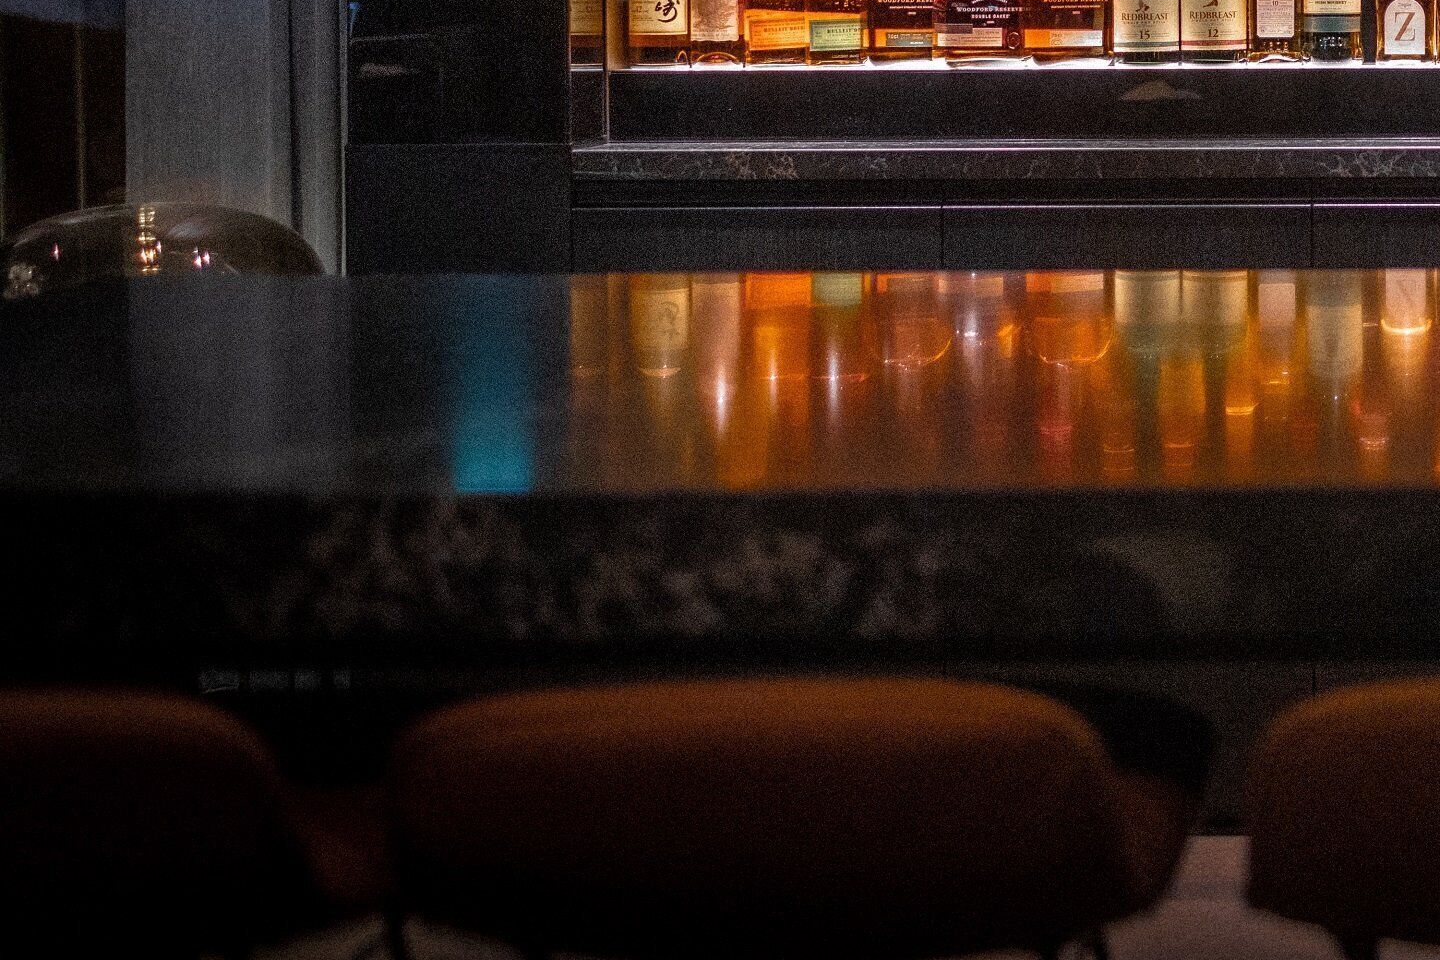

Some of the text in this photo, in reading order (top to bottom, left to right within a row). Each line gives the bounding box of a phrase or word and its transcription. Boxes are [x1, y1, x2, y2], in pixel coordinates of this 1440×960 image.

[1121, 12, 1169, 21] REDBREAST
[1189, 11, 1237, 19] REDBREAST
[1395, 12, 1416, 41] Z
[1139, 30, 1151, 39] 15
[1207, 29, 1219, 37] 12
